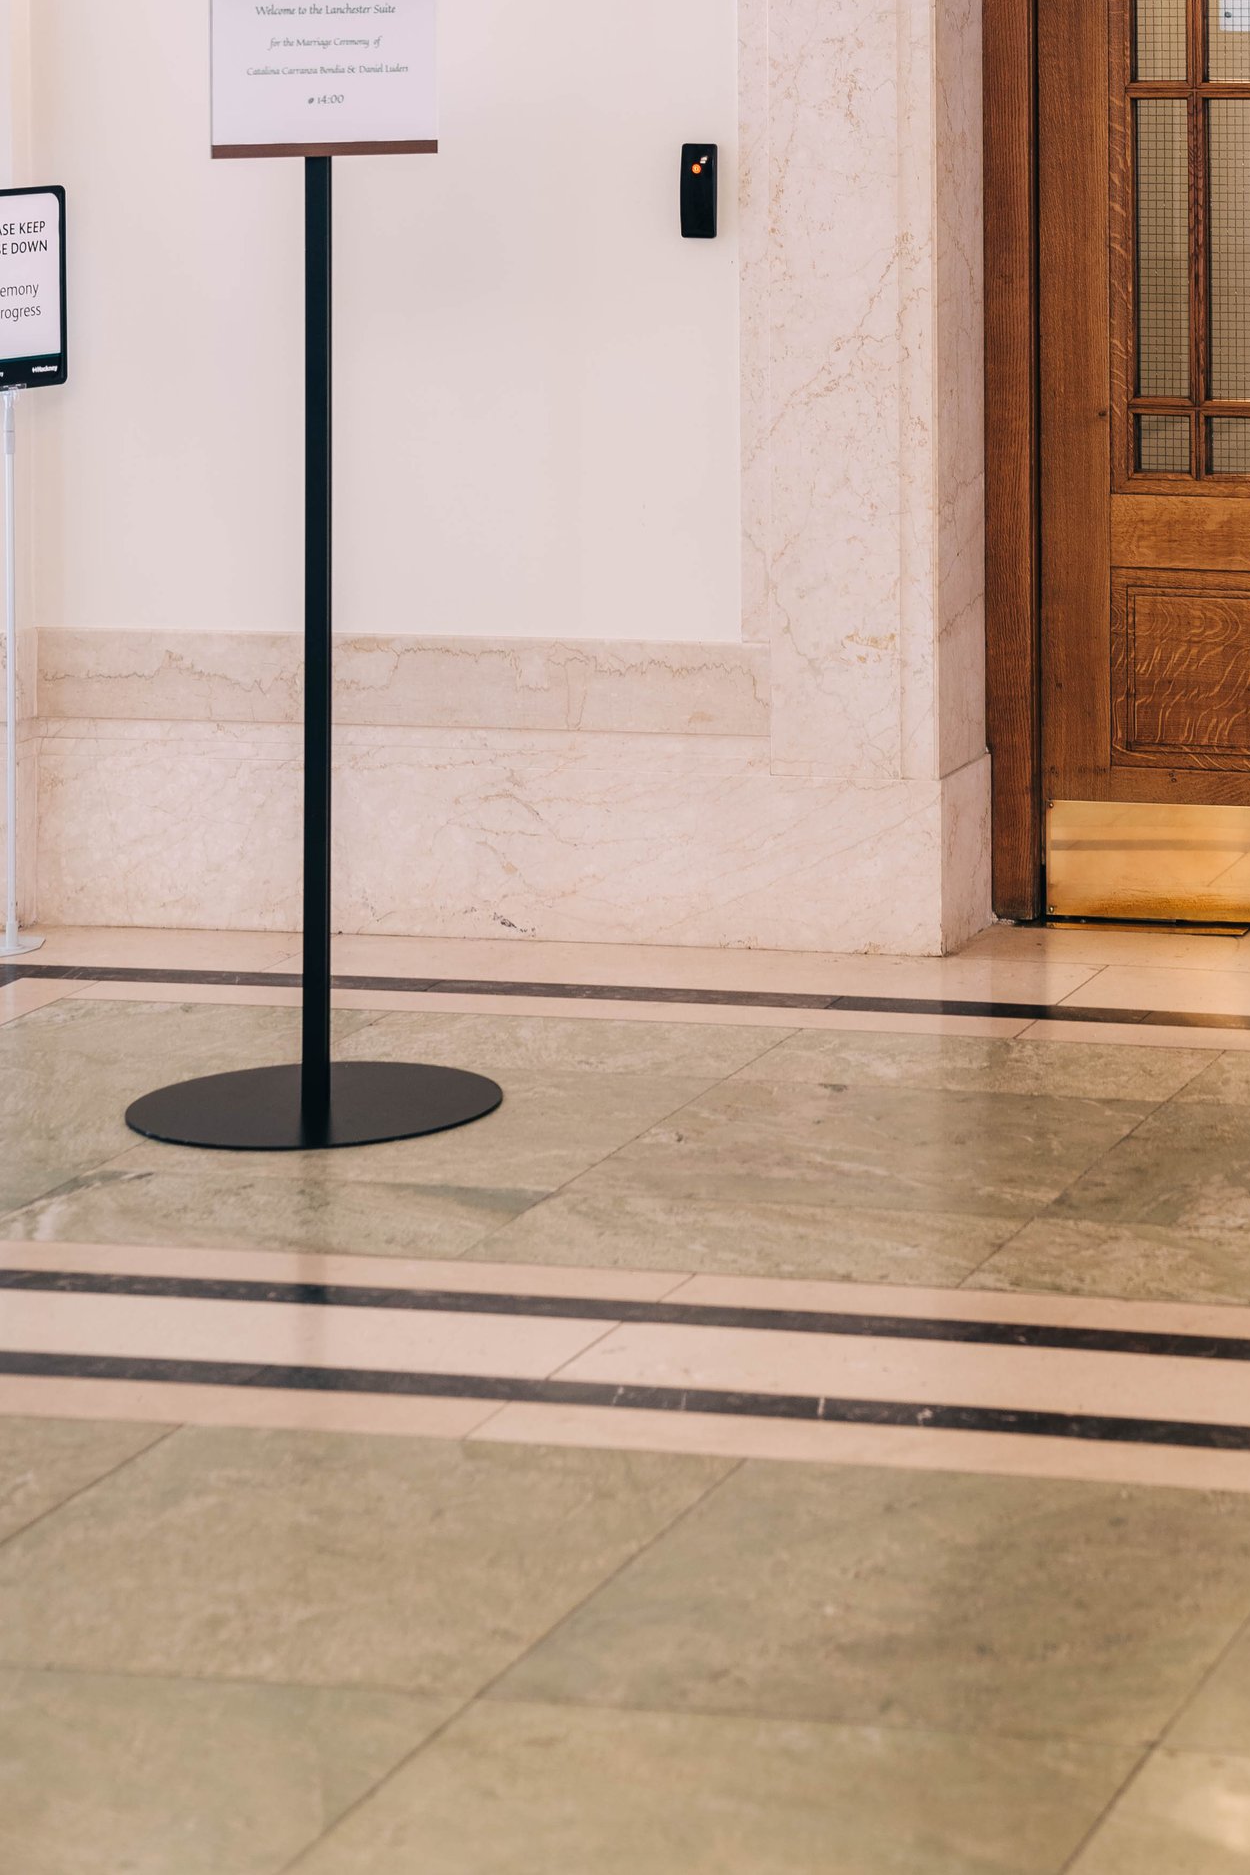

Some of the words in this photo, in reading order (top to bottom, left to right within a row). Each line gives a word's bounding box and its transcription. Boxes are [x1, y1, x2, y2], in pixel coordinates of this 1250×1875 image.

[255, 4, 296, 16] Welcome
[298, 5, 308, 15] to
[309, 3, 323, 15] the
[325, 3, 372, 15] Lanchester
[373, 3, 396, 14] Suite
[269, 37, 281, 51] for
[283, 37, 295, 47] the
[296, 37, 332, 49] Marriage
[333, 37, 370, 49] Ceremony
[373, 36, 383, 49] of
[347, 64, 356, 74] &
[359, 63, 384, 74] Daniel
[317, 94, 345, 105] 14:00
[19, 220, 46, 235] KEEP
[11, 239, 48, 255] DOWN
